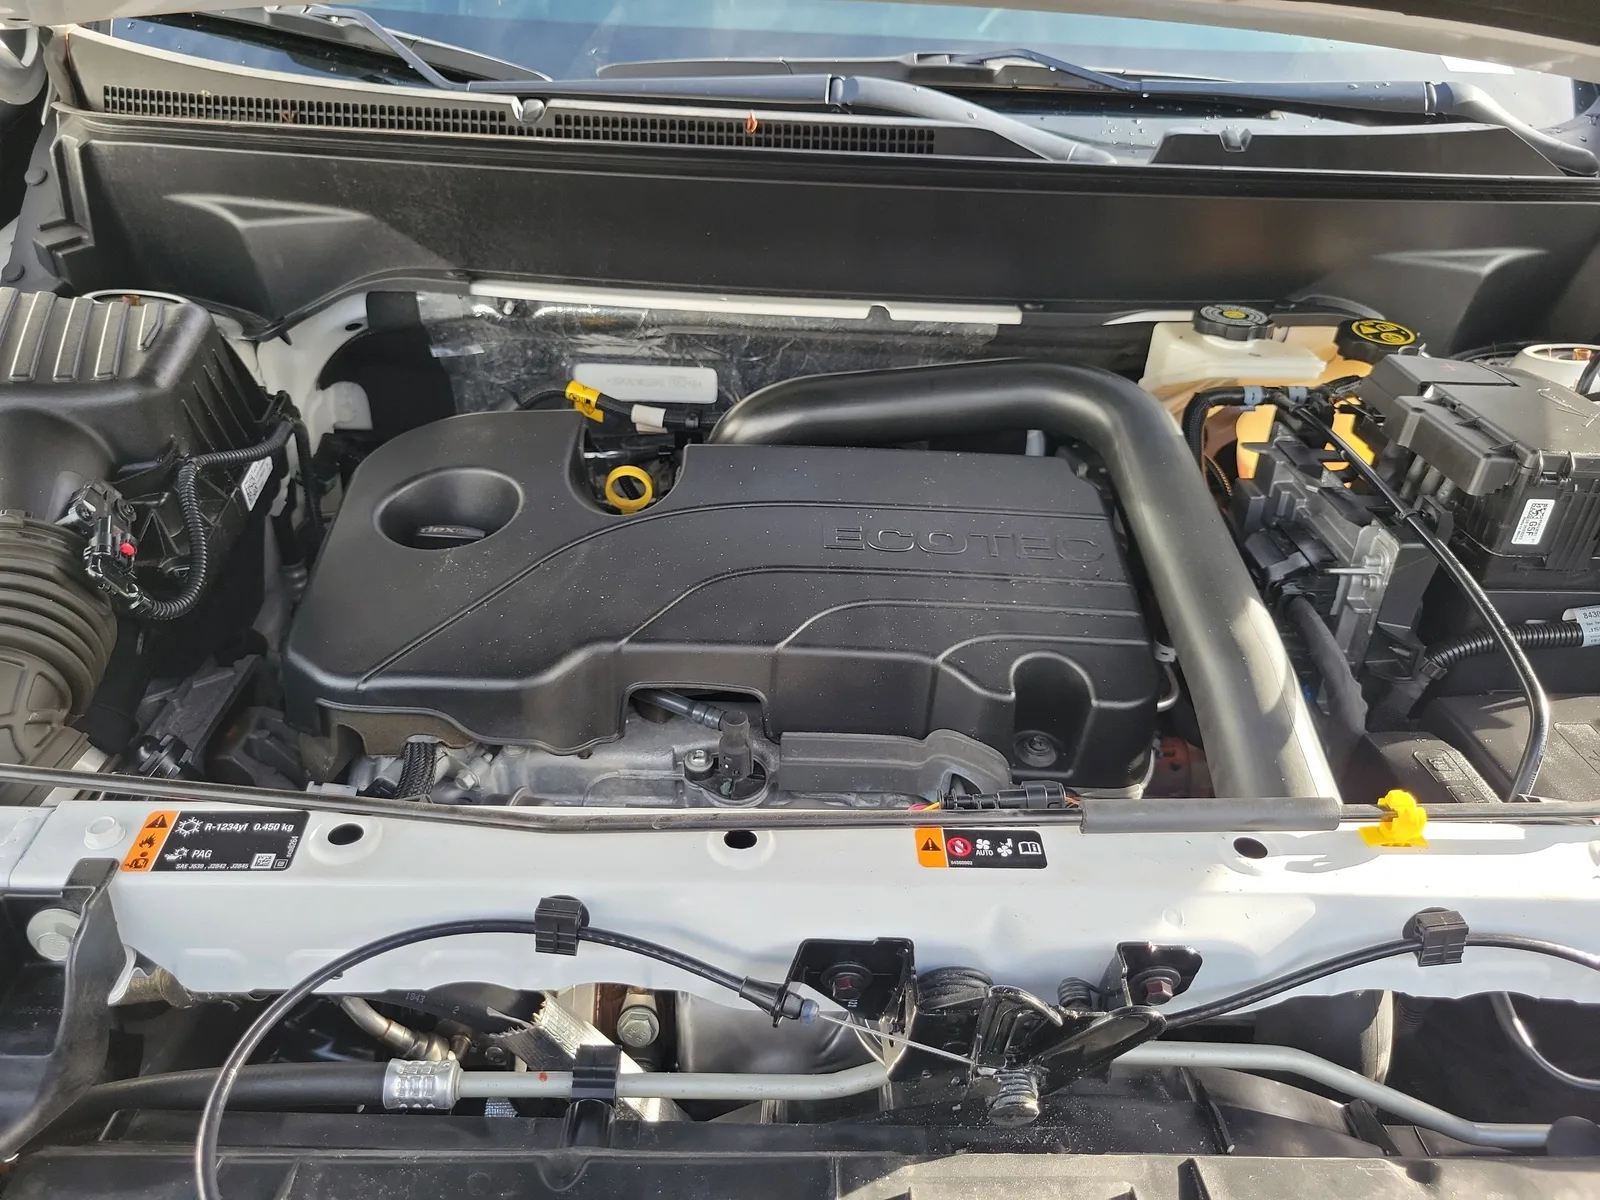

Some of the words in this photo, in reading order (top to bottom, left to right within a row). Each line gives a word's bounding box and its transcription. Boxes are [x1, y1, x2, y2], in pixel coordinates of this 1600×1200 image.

[823, 525, 1105, 562] ECOTEC
[204, 822, 248, 832] R-1234yf
[253, 822, 280, 831] 0.450
[281, 823, 295, 833] kg
[191, 849, 213, 858] PAG
[975, 849, 994, 857] AUTO
